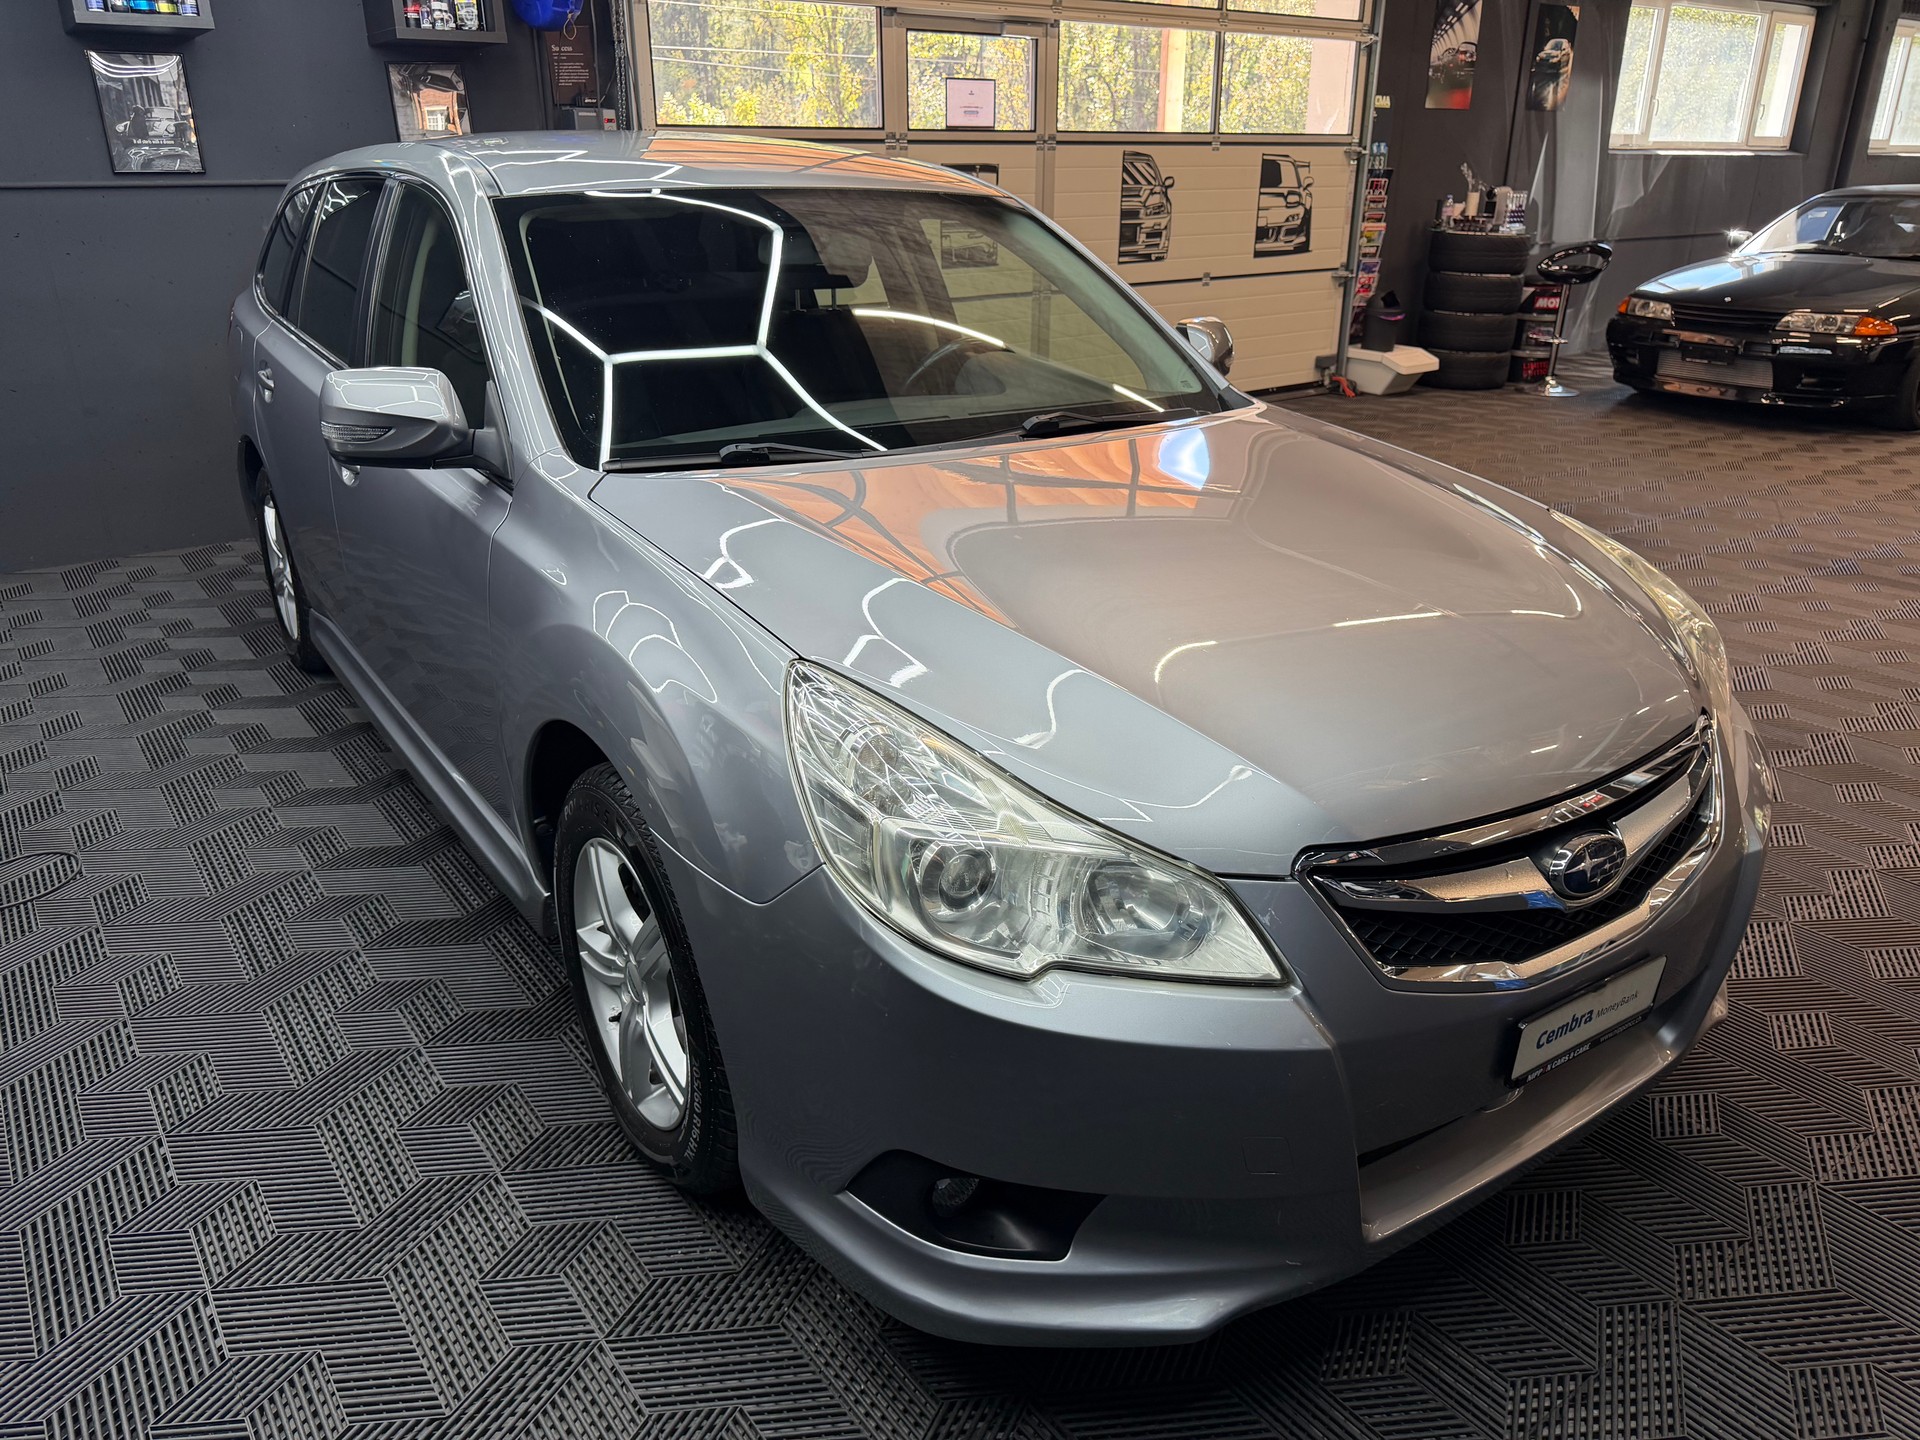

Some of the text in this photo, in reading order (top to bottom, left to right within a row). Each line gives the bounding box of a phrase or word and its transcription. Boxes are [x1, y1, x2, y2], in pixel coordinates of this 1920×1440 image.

[551, 44, 573, 52] Sucess
[1536, 991, 1638, 1050] Cembra MoneyBank
